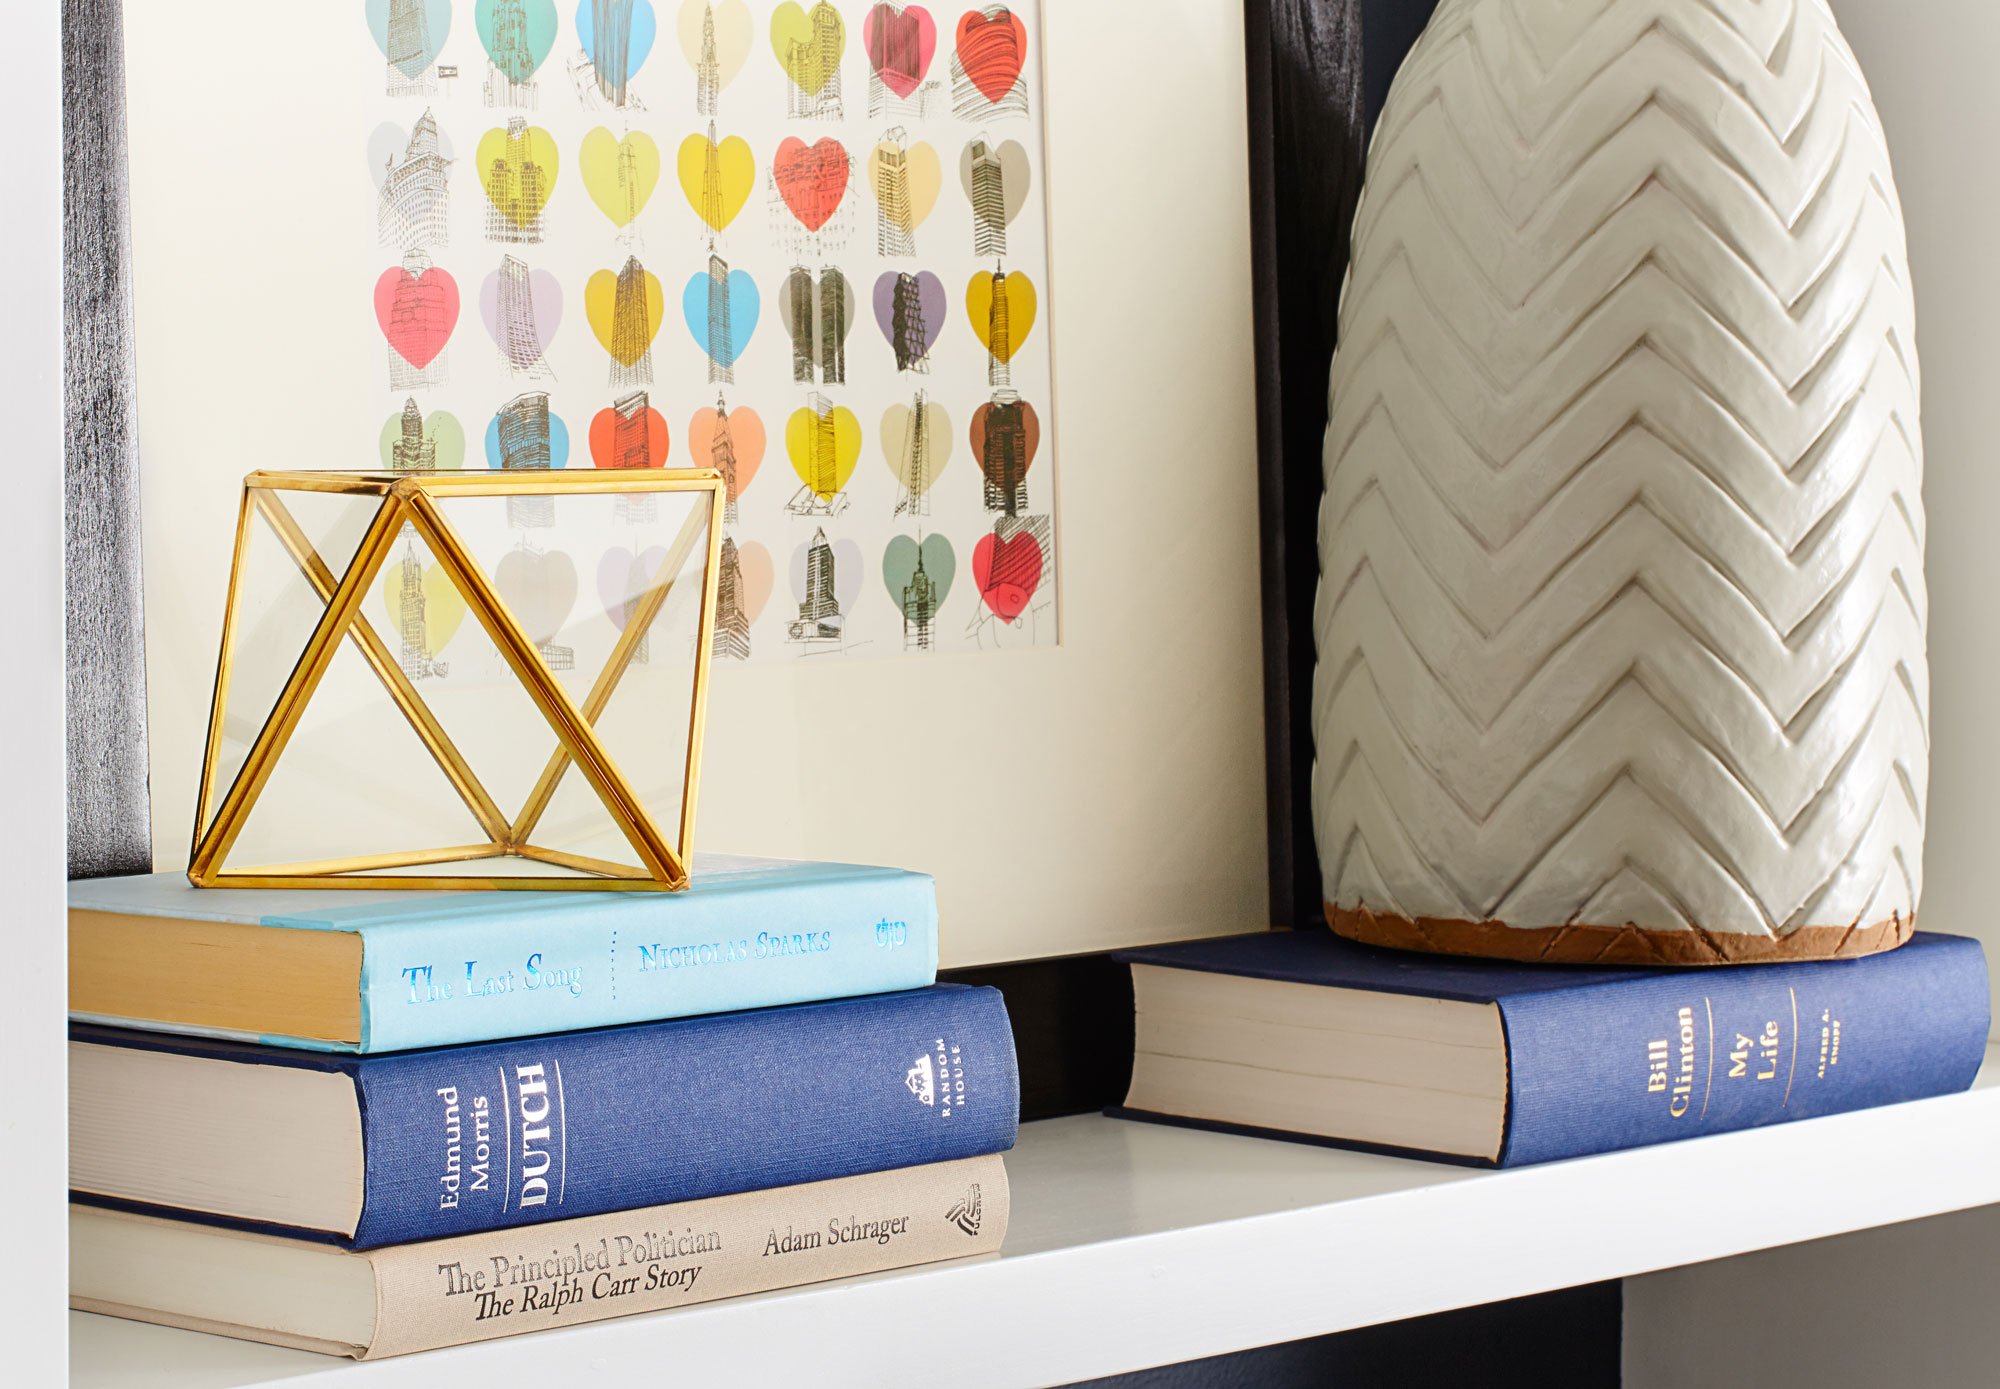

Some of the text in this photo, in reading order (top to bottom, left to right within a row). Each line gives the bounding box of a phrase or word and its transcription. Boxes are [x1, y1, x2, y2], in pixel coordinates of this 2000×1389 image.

[402, 953, 583, 1004] The Last Song
[637, 931, 830, 972] NICHOLAS SPARKS
[936, 1038, 951, 1117] RANDOM
[951, 1045, 965, 1106] HOUSE
[1648, 1039, 1668, 1093] Bill
[1670, 1006, 1694, 1118] Clinton
[1728, 1033, 1754, 1078] My
[1757, 1020, 1779, 1080] Life
[1817, 1026, 1830, 1079] ALFRED
[437, 1085, 461, 1210] Edmund
[470, 1096, 490, 1191] Morris
[516, 1062, 551, 1210] DUTCH
[438, 1227, 722, 1296] The Principled Politician
[762, 1214, 909, 1257] Adam Schrager
[474, 1264, 702, 1321] The Ralph Carr Story
